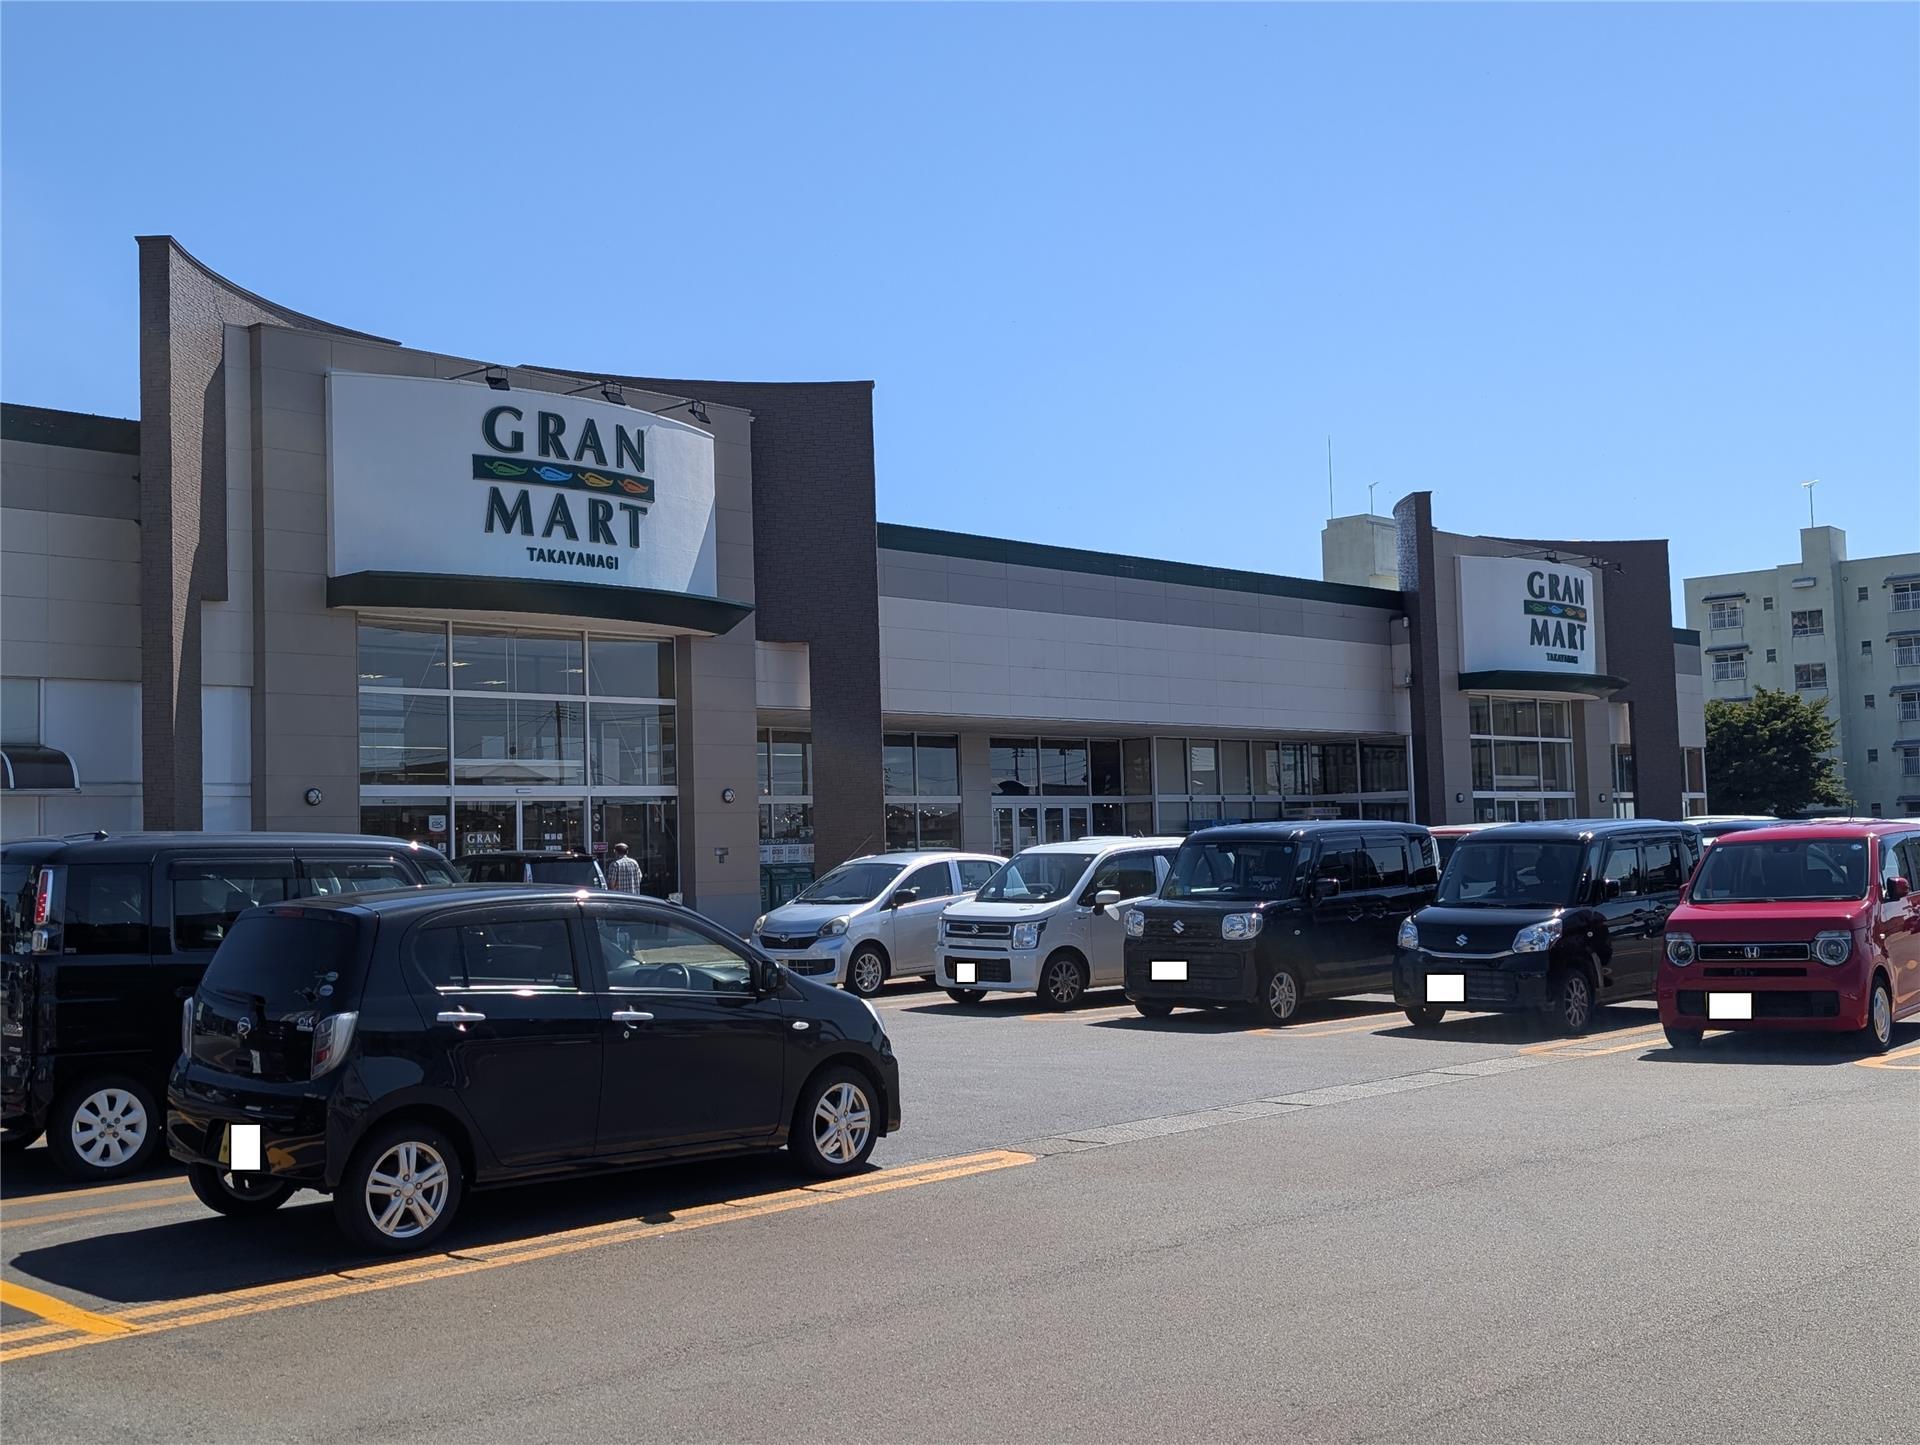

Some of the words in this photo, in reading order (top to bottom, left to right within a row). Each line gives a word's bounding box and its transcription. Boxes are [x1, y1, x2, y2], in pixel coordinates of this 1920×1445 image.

[482, 406, 646, 473] GRAN
[485, 487, 648, 548] MART
[526, 547, 619, 569] TAKAYANAGI
[1527, 572, 1584, 605] GRAN
[1530, 619, 1586, 650] MART
[467, 833, 501, 844] GRAN
